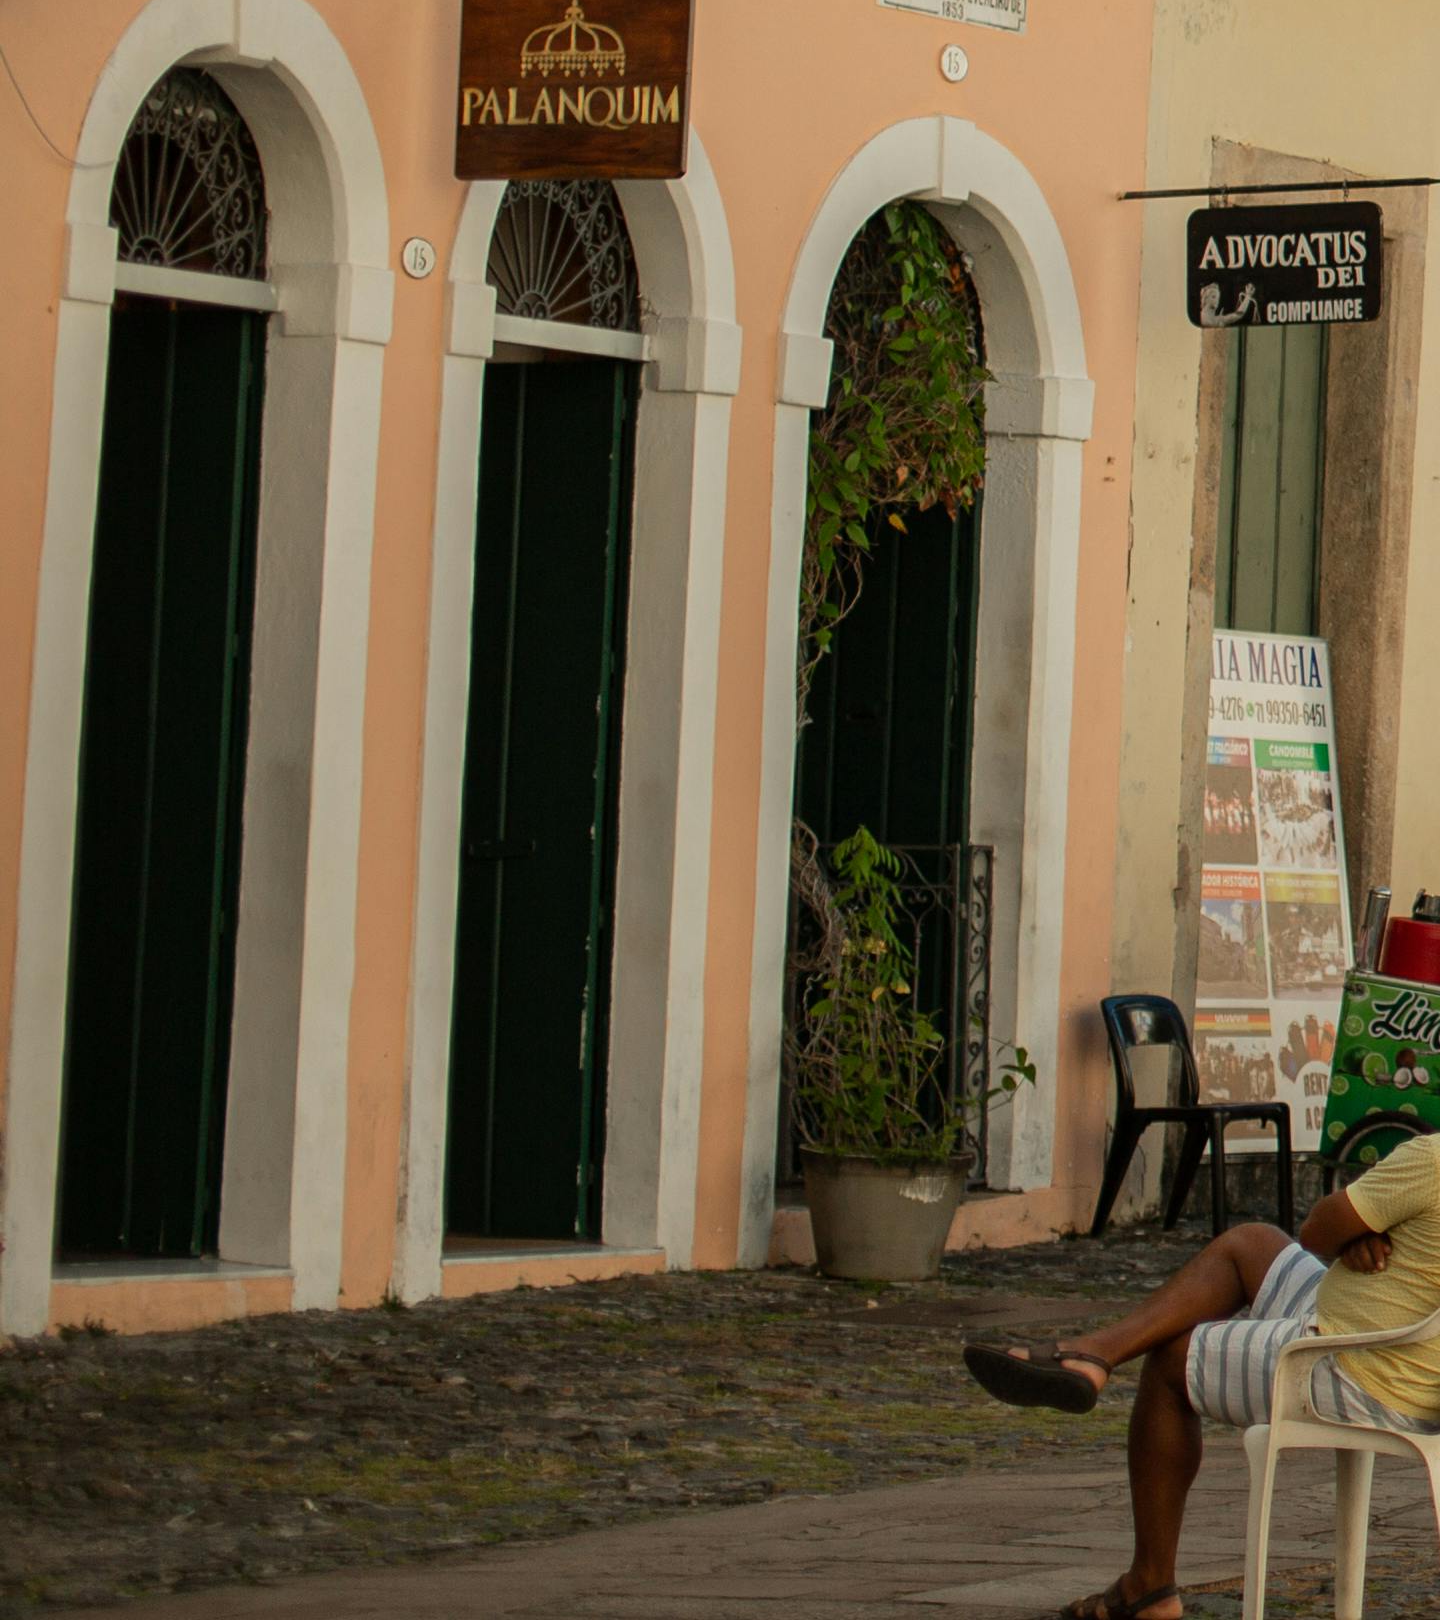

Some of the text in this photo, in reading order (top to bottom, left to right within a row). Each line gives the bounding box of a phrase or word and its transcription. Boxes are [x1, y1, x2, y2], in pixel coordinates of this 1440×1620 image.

[941, 1, 965, 20] 1853
[947, 51, 960, 74] 15
[461, 84, 680, 130] PALANQUIM
[411, 244, 427, 271] 15
[1199, 230, 1367, 269] ADVOCATUS
[1316, 265, 1366, 289] DEI
[1266, 298, 1363, 324] COMPLIANCE
[1210, 638, 1323, 688] IA MAGIA
[1266, 700, 1327, 728] 99350-6451
[1304, 1072, 1329, 1097] RENT
[1306, 1107, 1313, 1130] A
